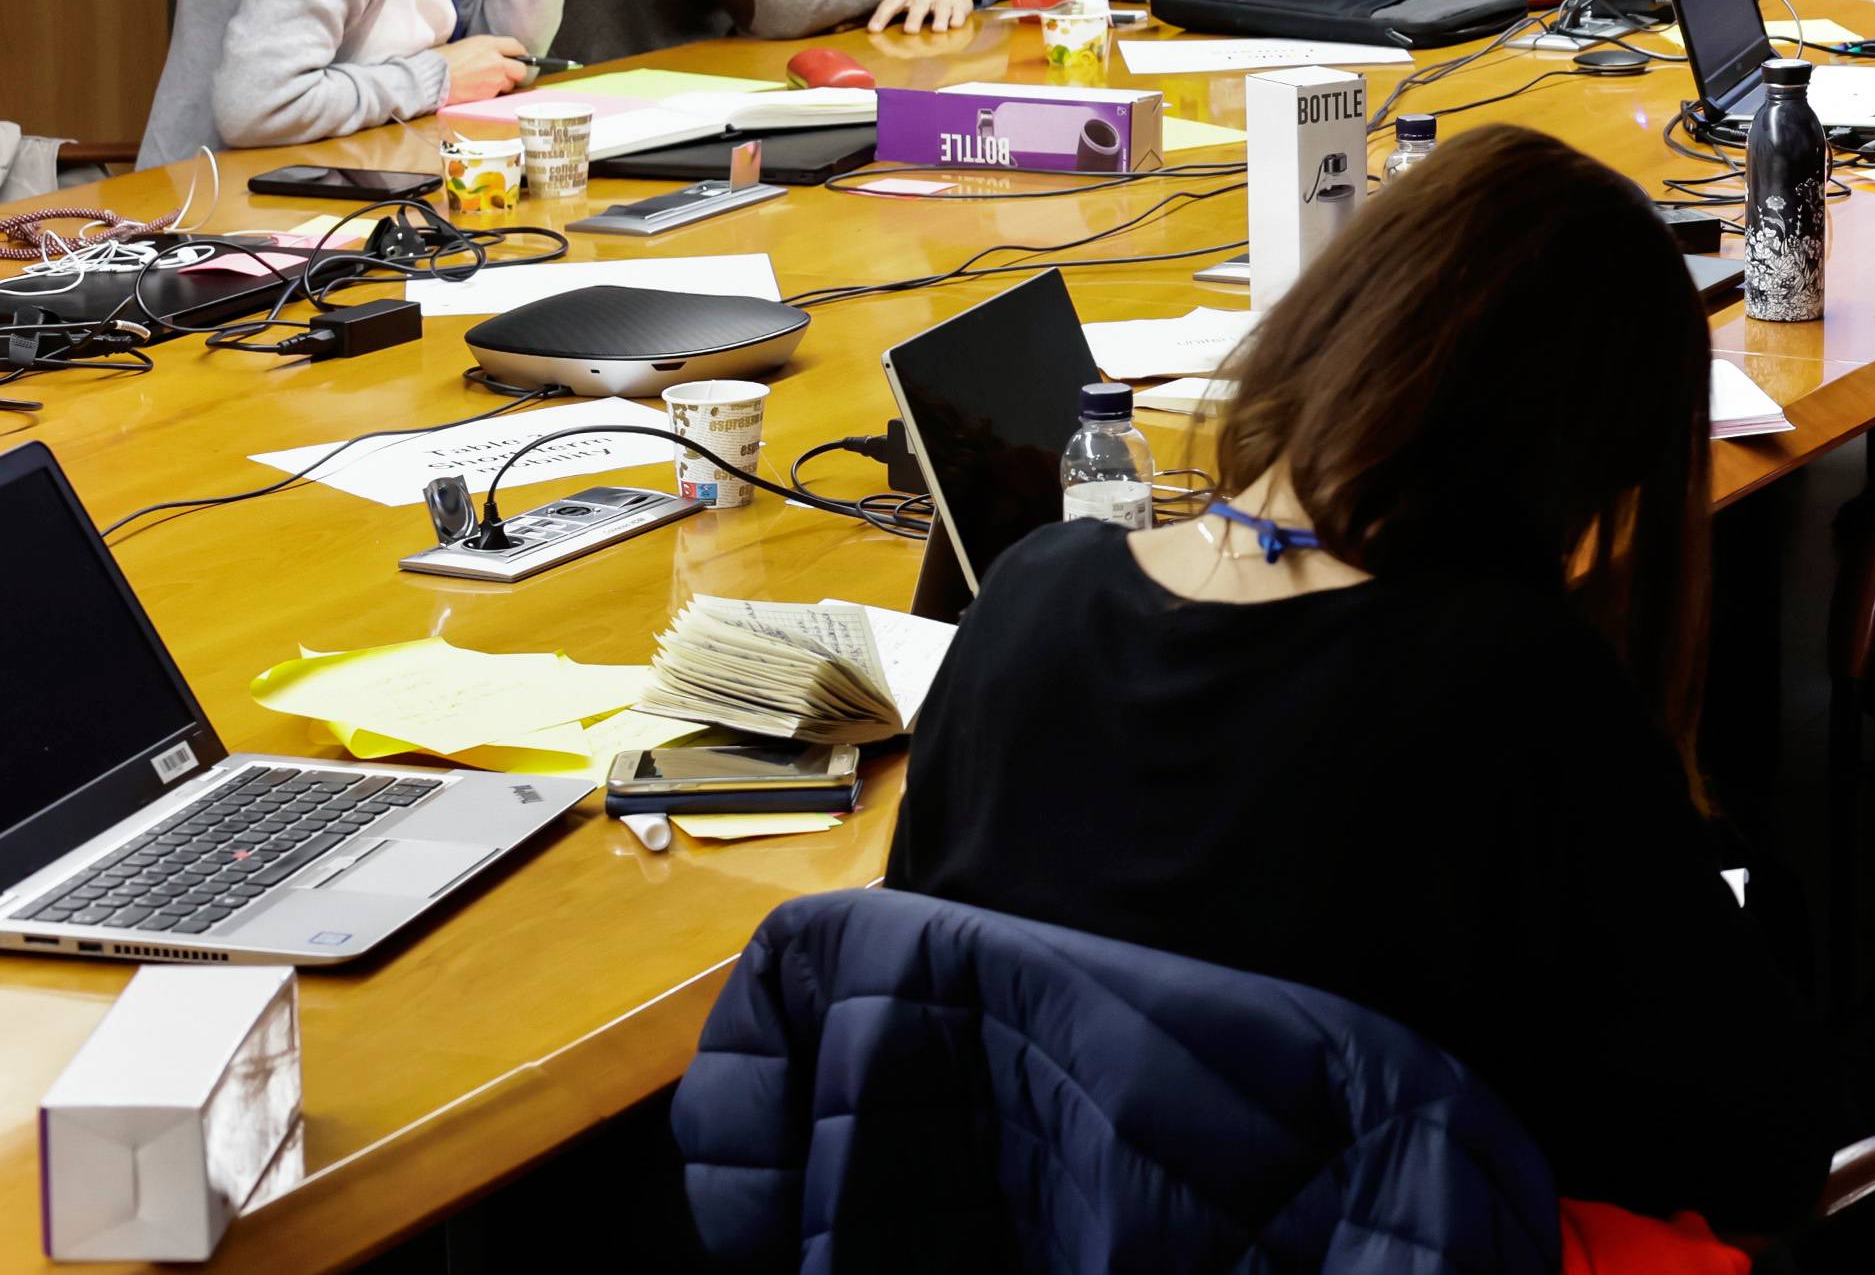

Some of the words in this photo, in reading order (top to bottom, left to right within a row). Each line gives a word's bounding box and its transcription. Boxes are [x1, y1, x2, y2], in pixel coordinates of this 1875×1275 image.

[1297, 89, 1363, 125] BOTTLE
[940, 133, 1010, 165] BOTTLE
[424, 438, 522, 458] Table
